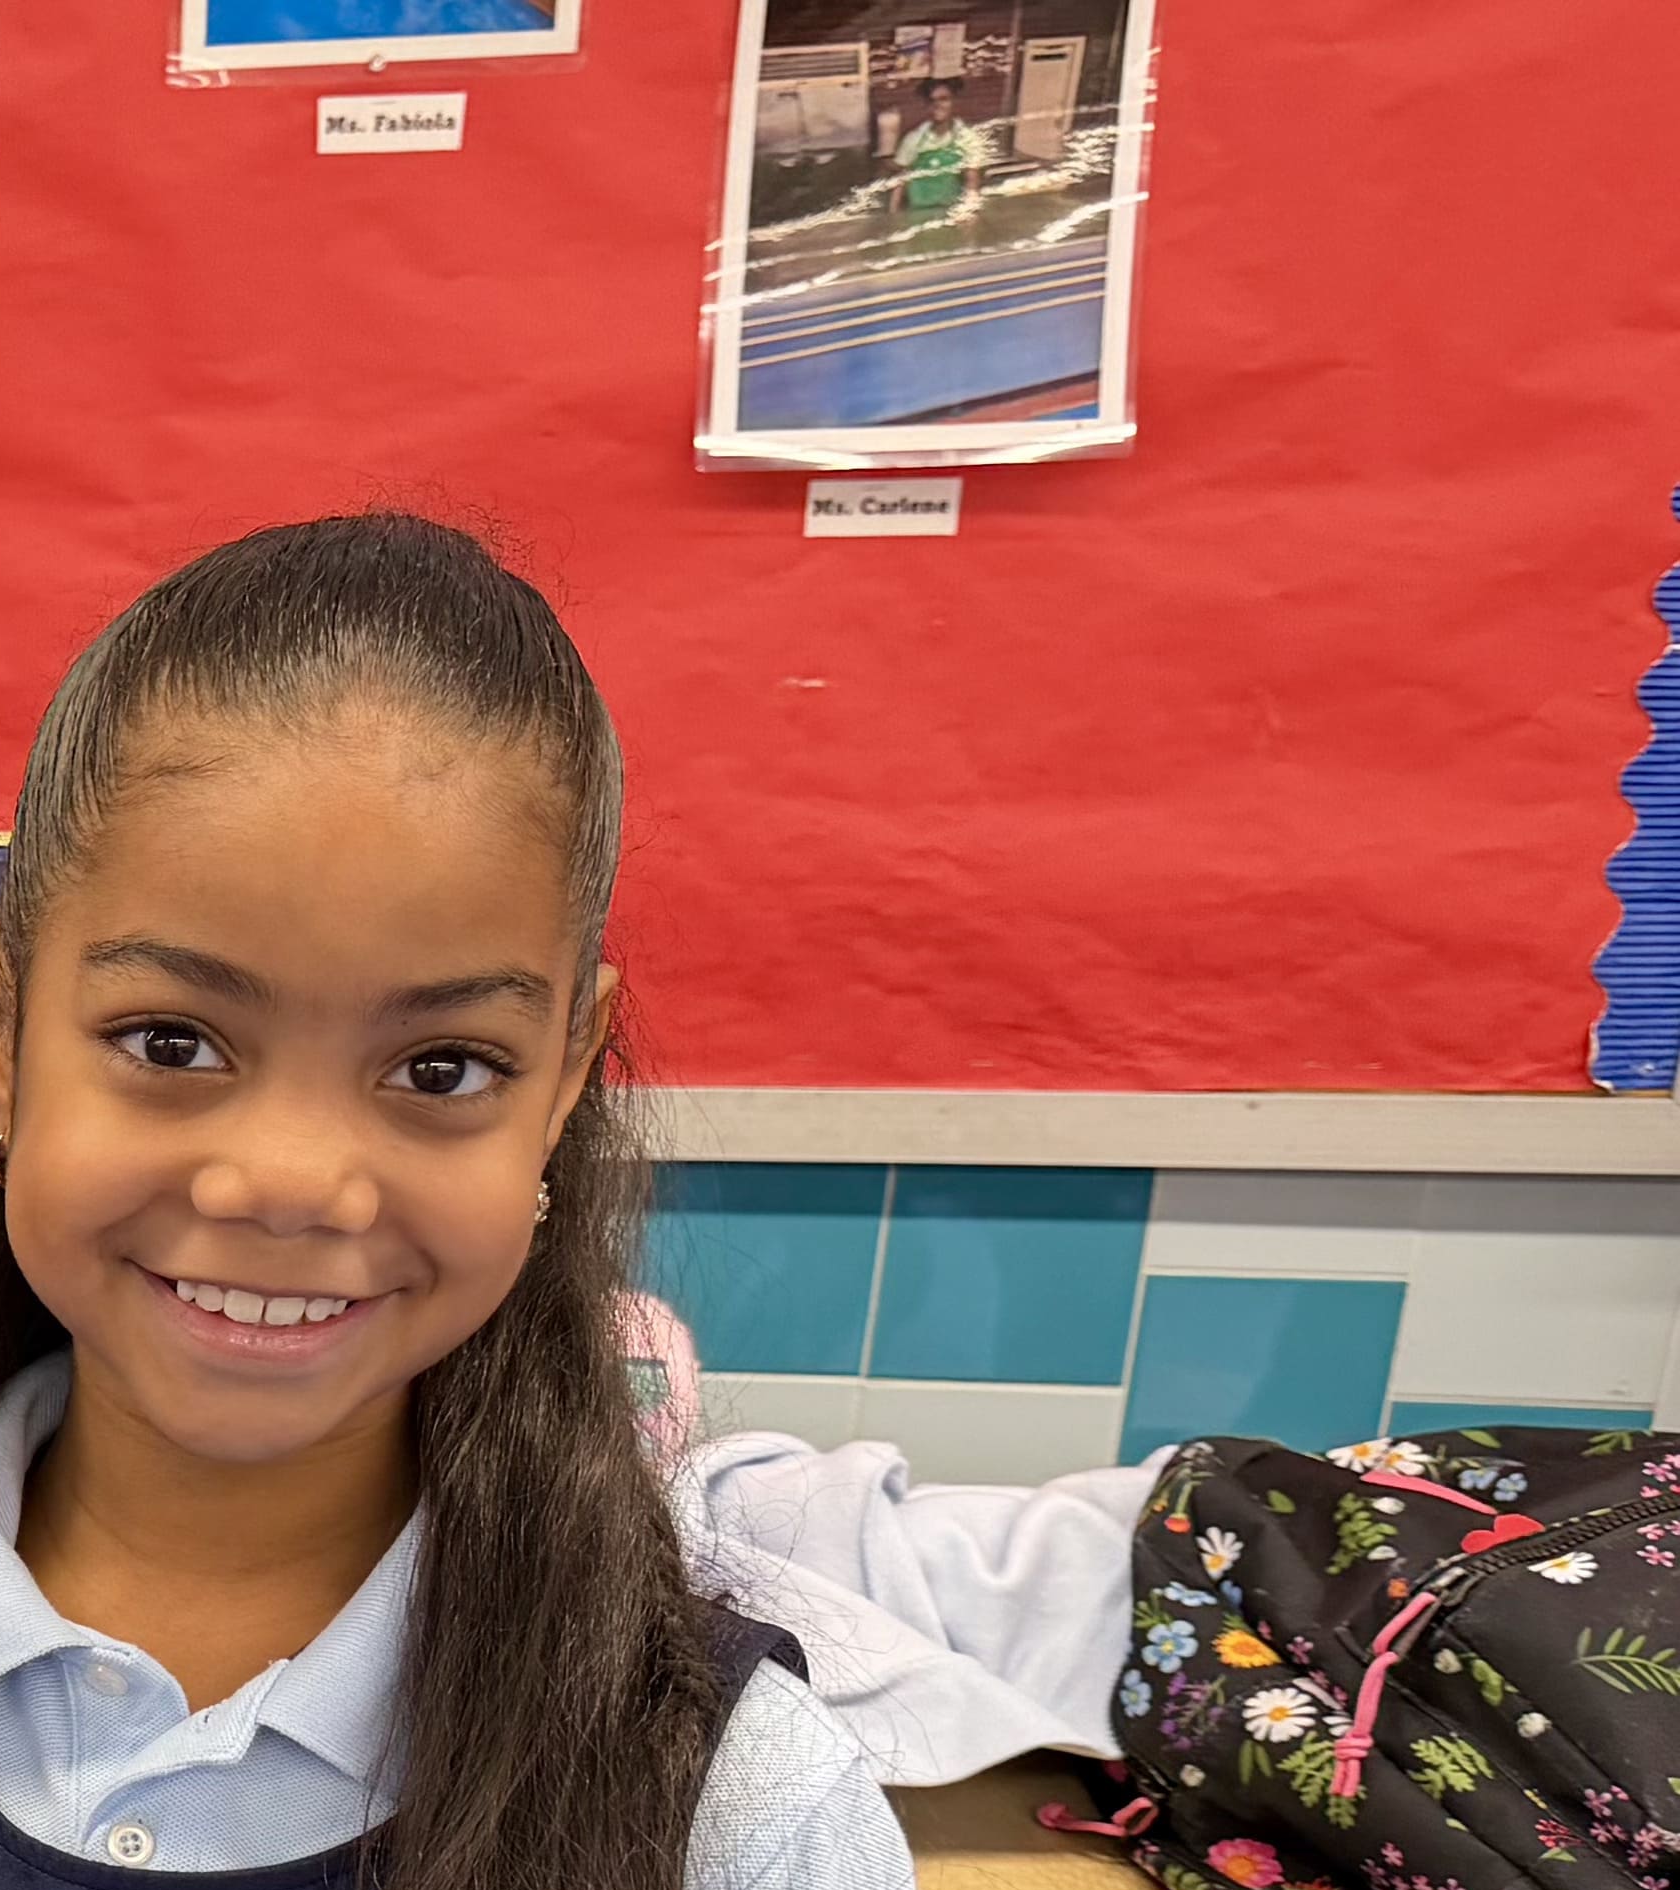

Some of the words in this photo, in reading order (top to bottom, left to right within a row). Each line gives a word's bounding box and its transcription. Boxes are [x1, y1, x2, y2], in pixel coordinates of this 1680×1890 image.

[325, 115, 366, 135] Ms.
[373, 111, 457, 132] Fabiola
[812, 499, 853, 516] Ms.
